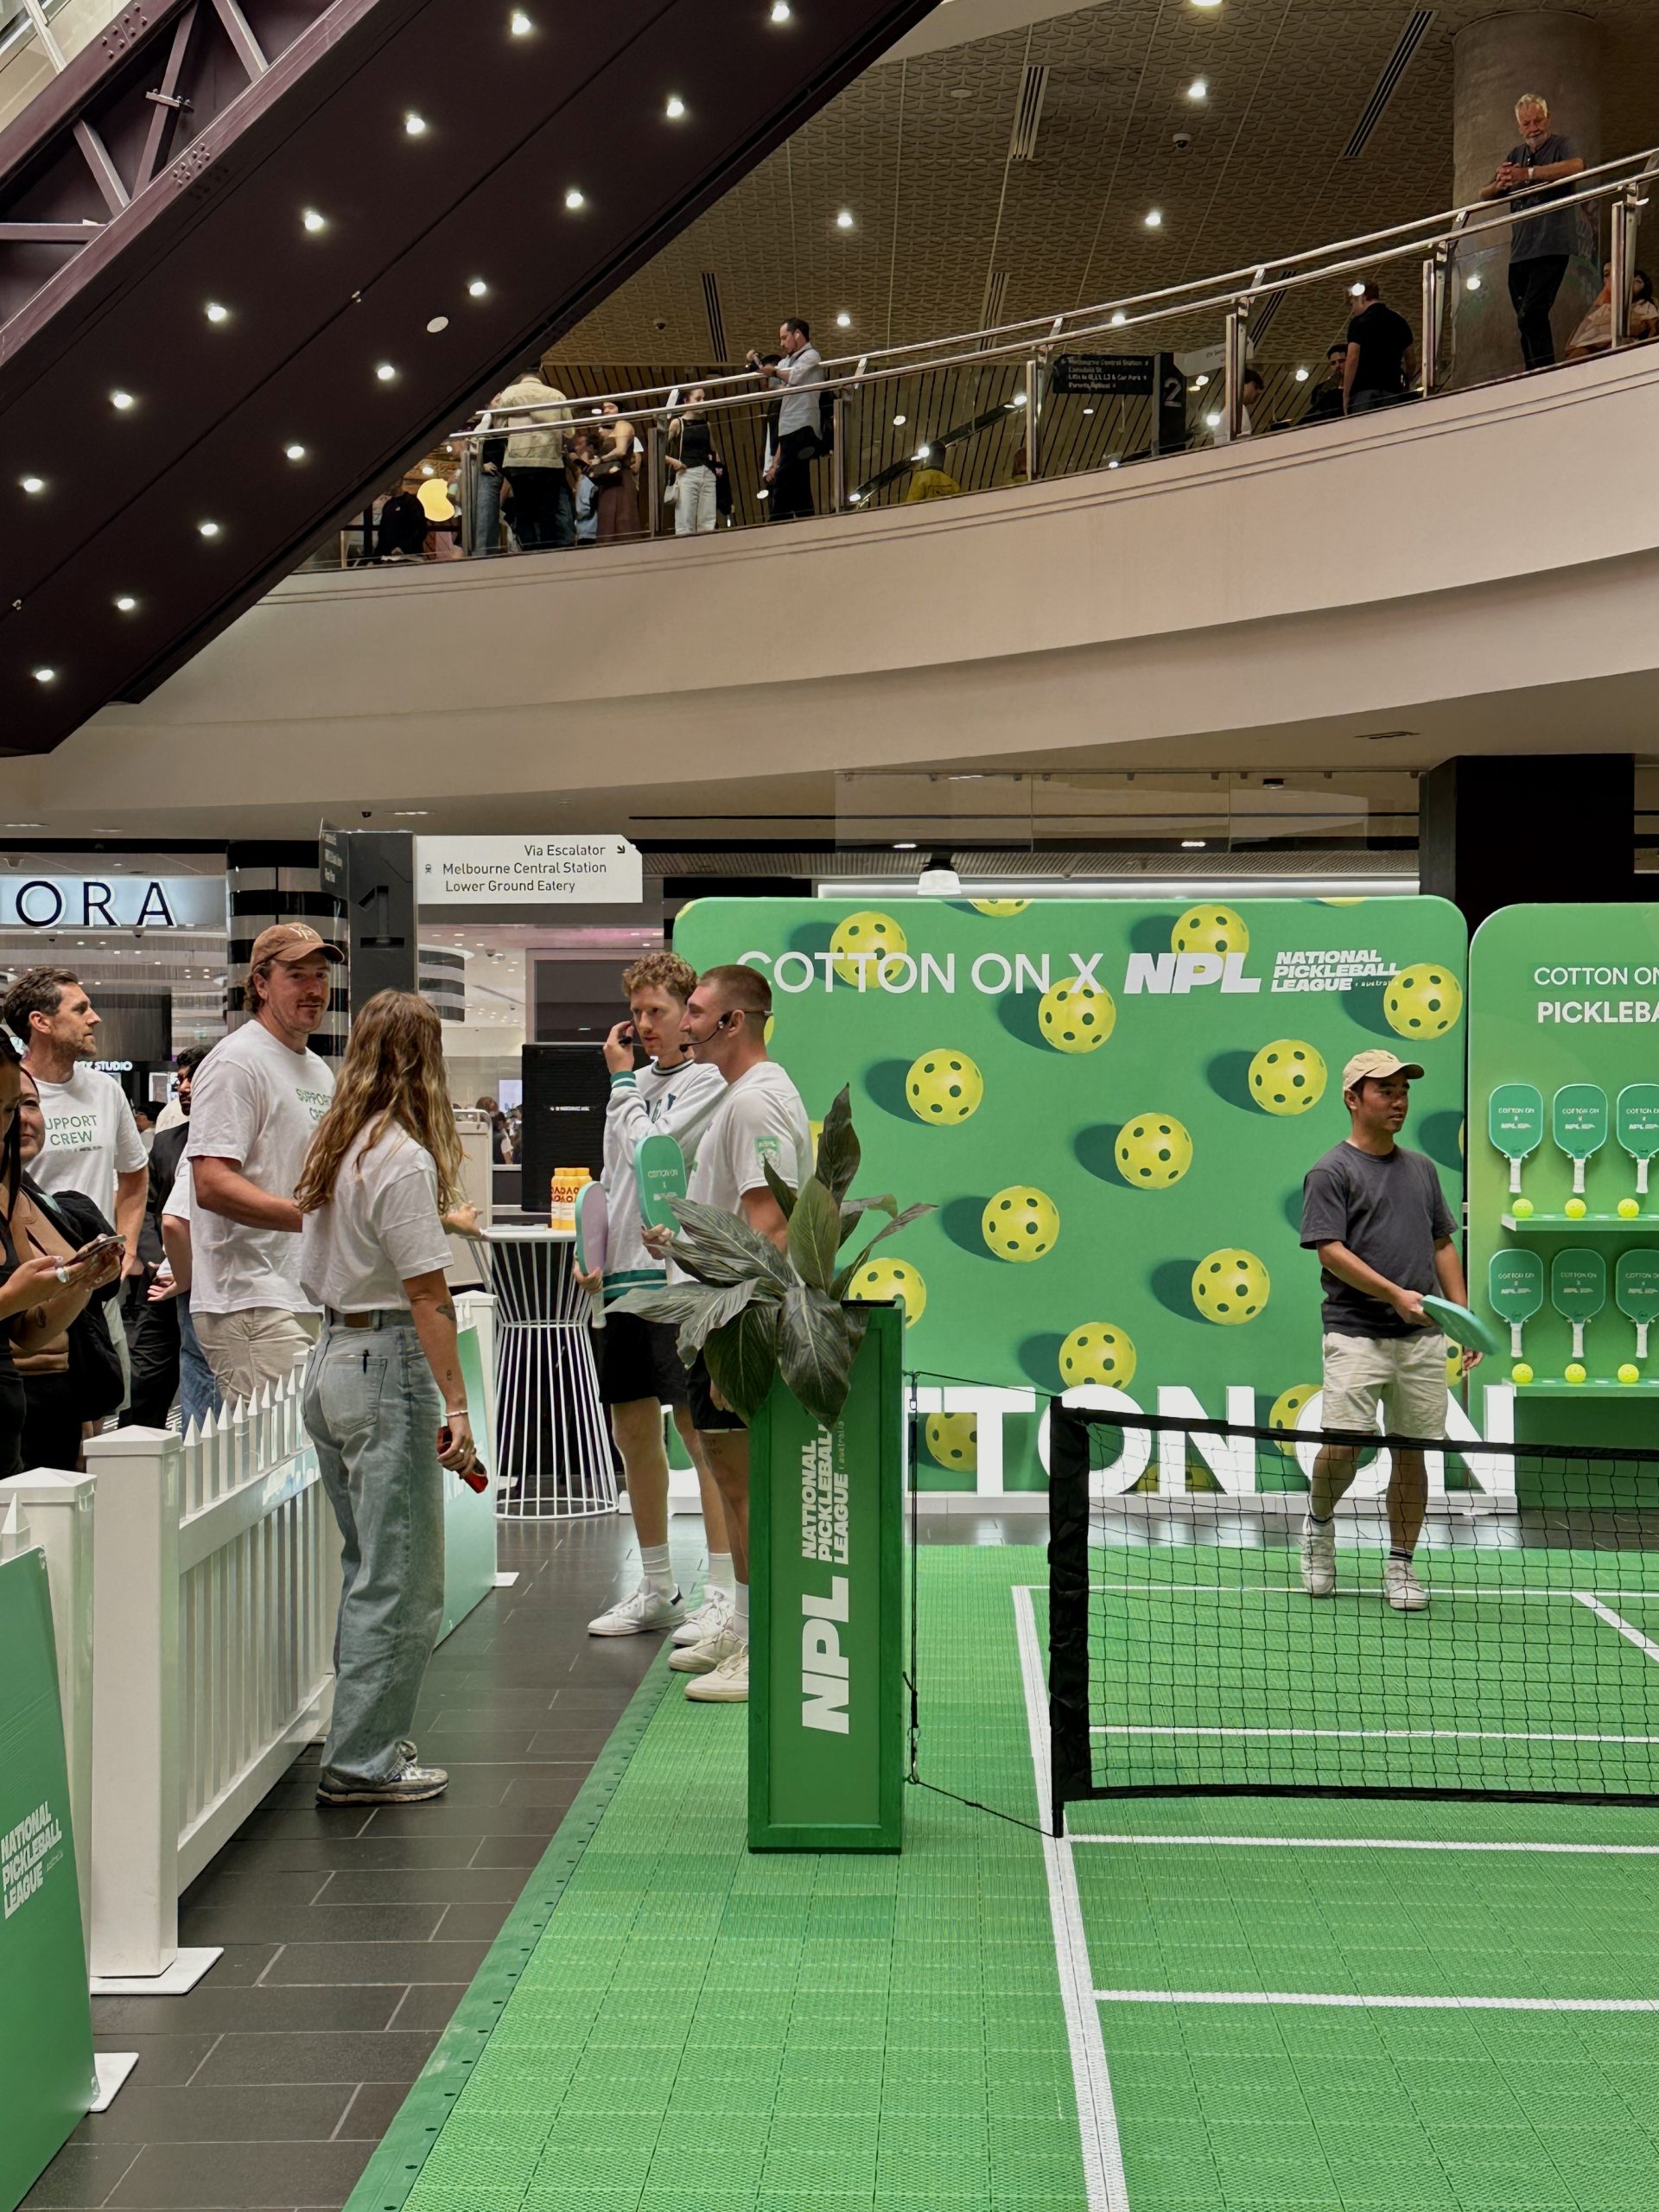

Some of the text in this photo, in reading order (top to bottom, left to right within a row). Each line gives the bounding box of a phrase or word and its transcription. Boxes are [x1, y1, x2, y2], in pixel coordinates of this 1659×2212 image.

[1164, 378, 1182, 408] 2
[524, 844, 607, 856] Via Escalator
[442, 861, 607, 874] Melbourne Central Station
[445, 880, 575, 893] Lower Ground Eatery
[16, 880, 177, 928] ORA
[1275, 949, 1382, 965] NATIONAL
[970, 952, 1050, 995] ON
[1068, 952, 1104, 995] X
[1123, 951, 1262, 995] NPL
[1273, 963, 1402, 979] PICKLEBALL
[1534, 967, 1628, 985] COTTON
[1270, 977, 1354, 993] LEAGUE
[95, 1060, 133, 1071] STUDIO
[45, 1115, 98, 1130] UPPORT
[49, 1130, 92, 1146] CREW
[1295, 1384, 1516, 1496] ON
[801, 1440, 817, 1559] NATIONAL
[834, 1472, 849, 1565] LEAGUE
[802, 1575, 849, 1735] NPL
[1, 1801, 52, 1864] NATIONAL
[2, 1818, 62, 1892] PICKLEBALL
[4, 1860, 43, 1920] LEAGUE
